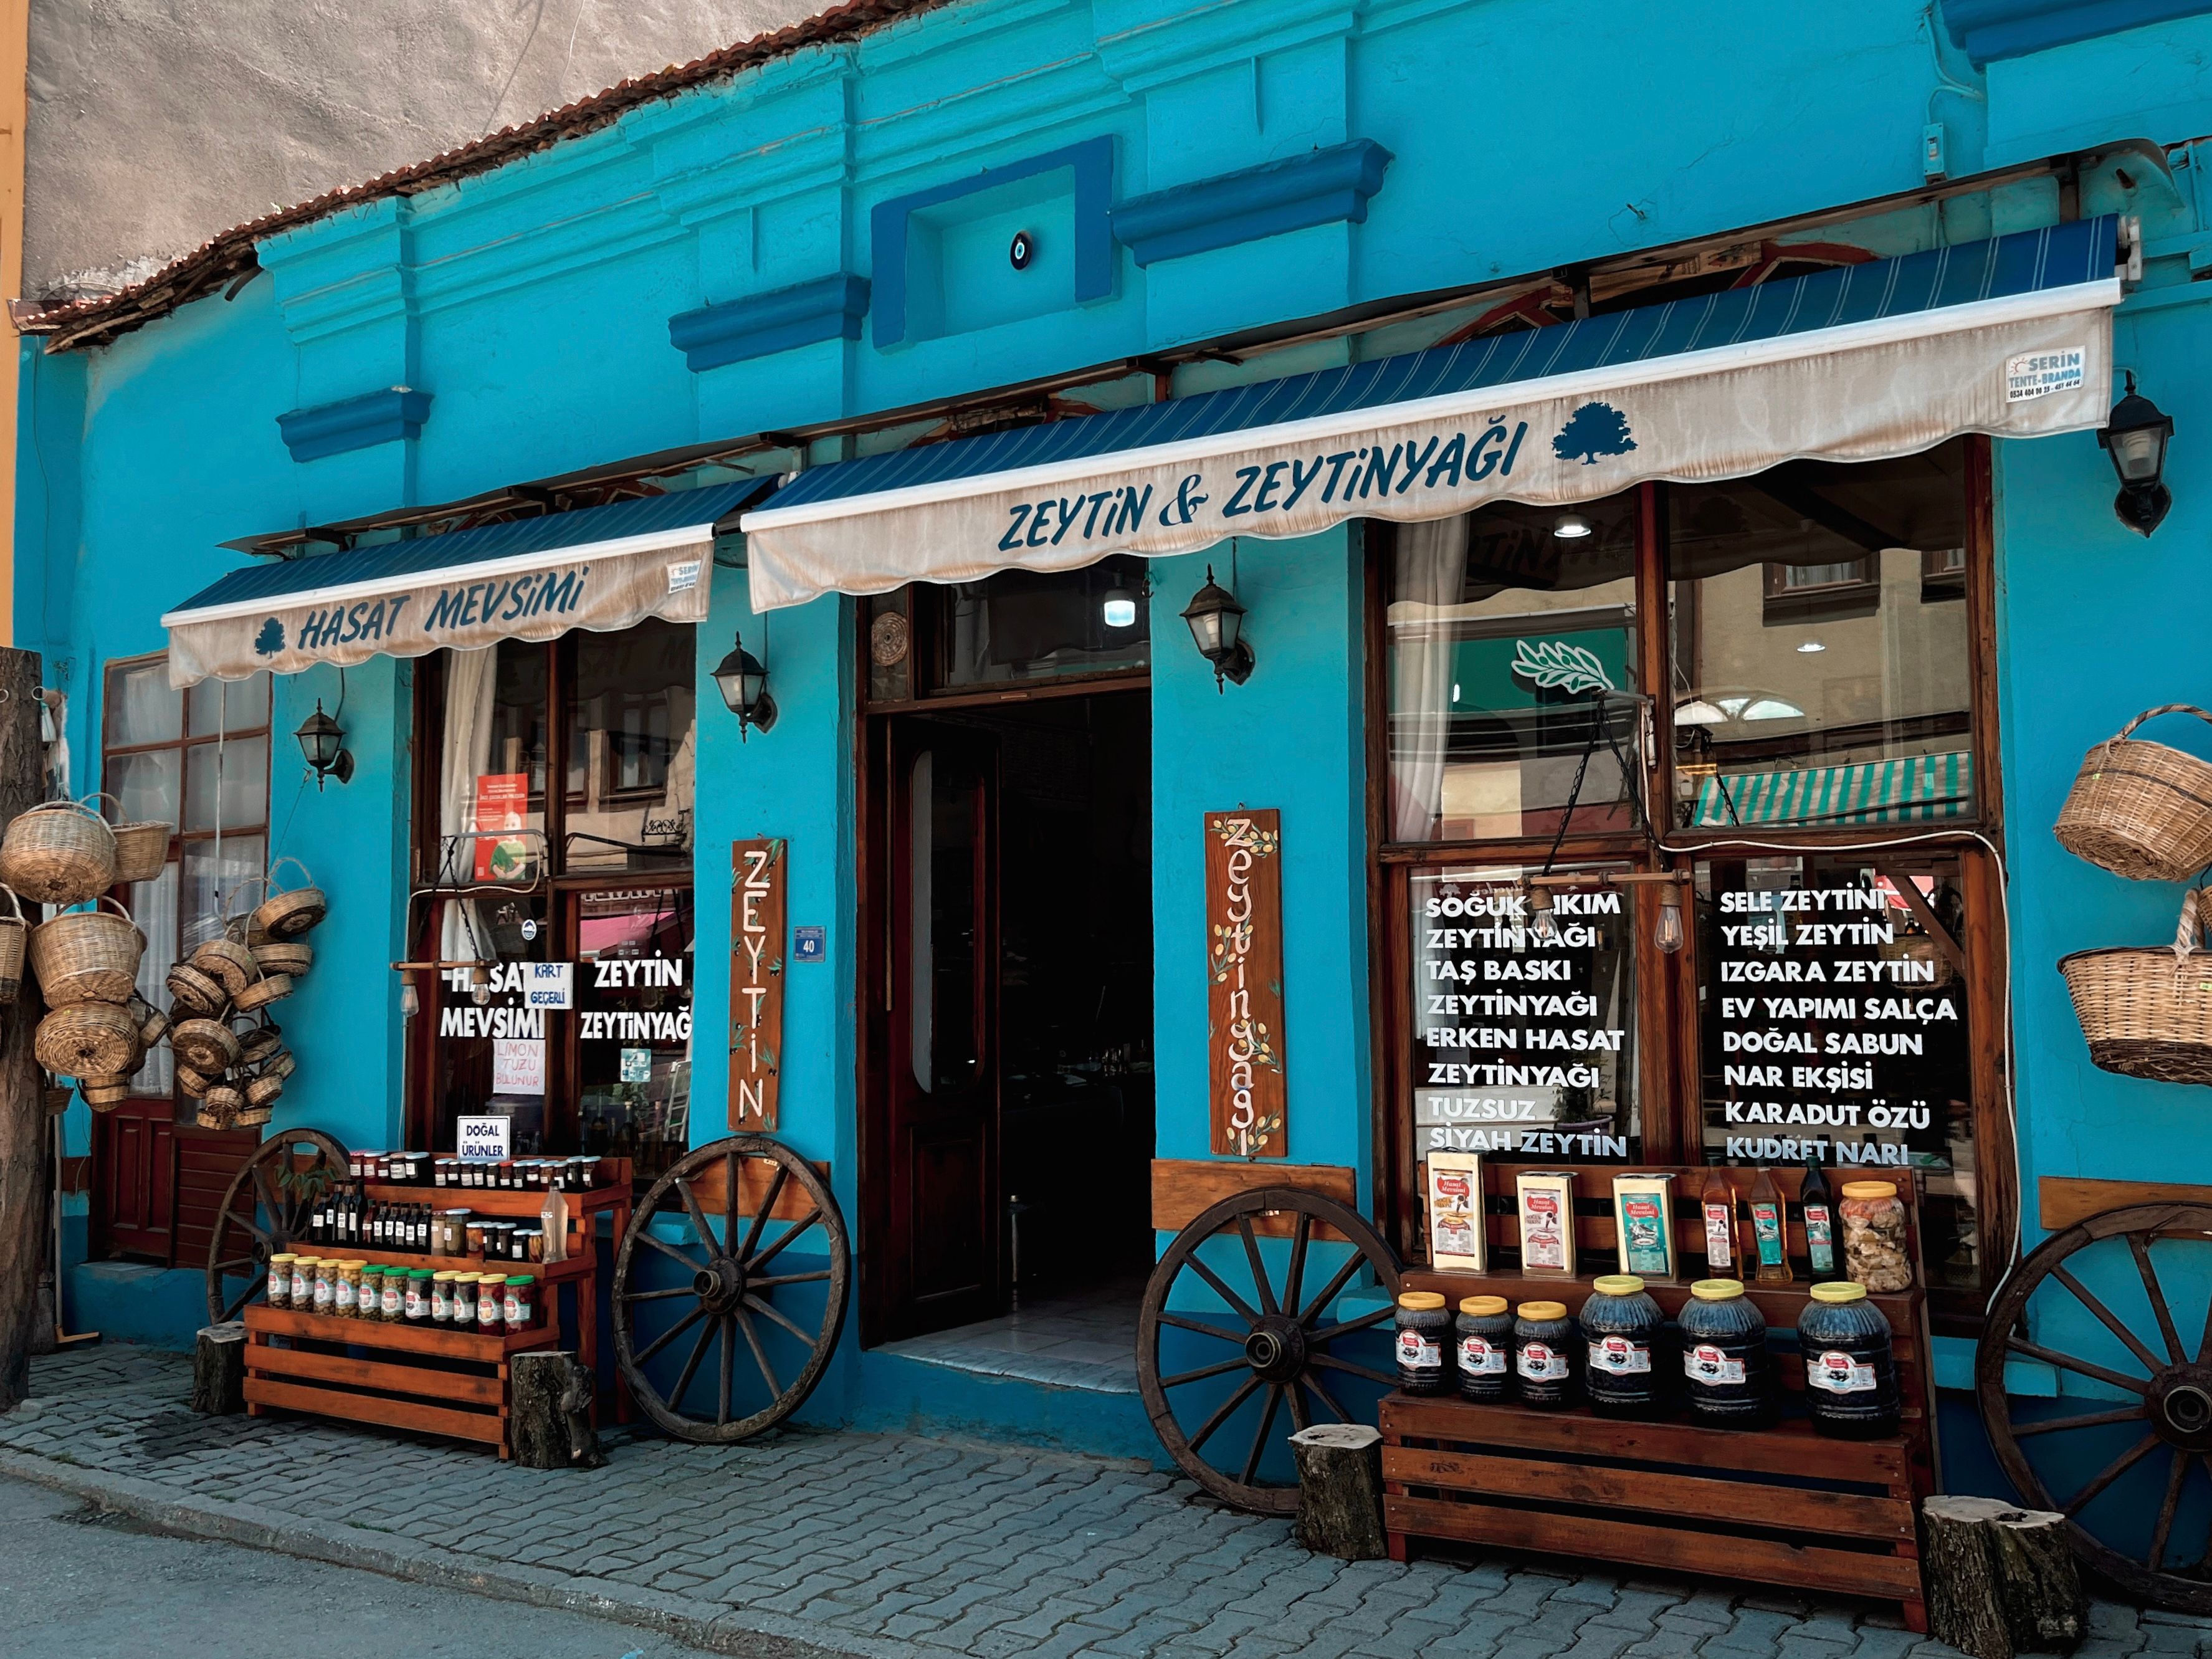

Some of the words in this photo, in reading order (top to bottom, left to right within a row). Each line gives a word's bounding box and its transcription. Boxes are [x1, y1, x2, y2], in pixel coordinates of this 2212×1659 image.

[2028, 350, 2079, 371] SERİN
[1158, 472, 1208, 527] &
[298, 595, 411, 650] HASAT
[1425, 892, 1527, 918] SOĞUK
[1553, 894, 1620, 915] IKIM
[1720, 891, 1771, 912] SELE
[803, 940, 814, 952] 40
[1721, 918, 1788, 950] YEŞİL
[1796, 916, 1894, 945] ZEYTİN
[535, 963, 563, 978] KART
[594, 949, 683, 988] ZEYTİN
[1426, 960, 1475, 985] TAŞ
[1484, 960, 1570, 980] BASKI
[1721, 961, 1826, 982] IZGARA
[1834, 953, 1934, 982] ZEYTİN
[1428, 988, 1597, 1016] ZEYTİNYAĞI
[1722, 998, 1755, 1018] EV
[1763, 998, 1856, 1020] YAPIMI
[1864, 998, 1958, 1025] SALÇA
[1427, 1028, 1517, 1049] ERKEN
[1527, 1029, 1624, 1051] HASAT
[1723, 1027, 1817, 1053] DOĞAL
[1824, 1033, 1923, 1055] SABUN
[503, 1058, 536, 1071] TUZU
[1428, 1058, 1599, 1088] ZEYTİNYAĞI
[1724, 1065, 1785, 1088] NAR
[1792, 1061, 1873, 1093] EKŞİSİ
[496, 1073, 538, 1086] BULUNUR
[1428, 1096, 1536, 1121] TUZSUZ
[1725, 1101, 1861, 1127] KARADUT
[1867, 1099, 1930, 1130] ÖZÜ
[467, 1122, 499, 1136] DOĞAL
[1429, 1122, 1511, 1151] SİYAH
[1520, 1128, 1626, 1157] ZEYTİN
[462, 1140, 503, 1156] ÜRÜNLER
[1726, 1137, 1828, 1161] KUDRET
[1836, 1141, 1909, 1165] NARI
